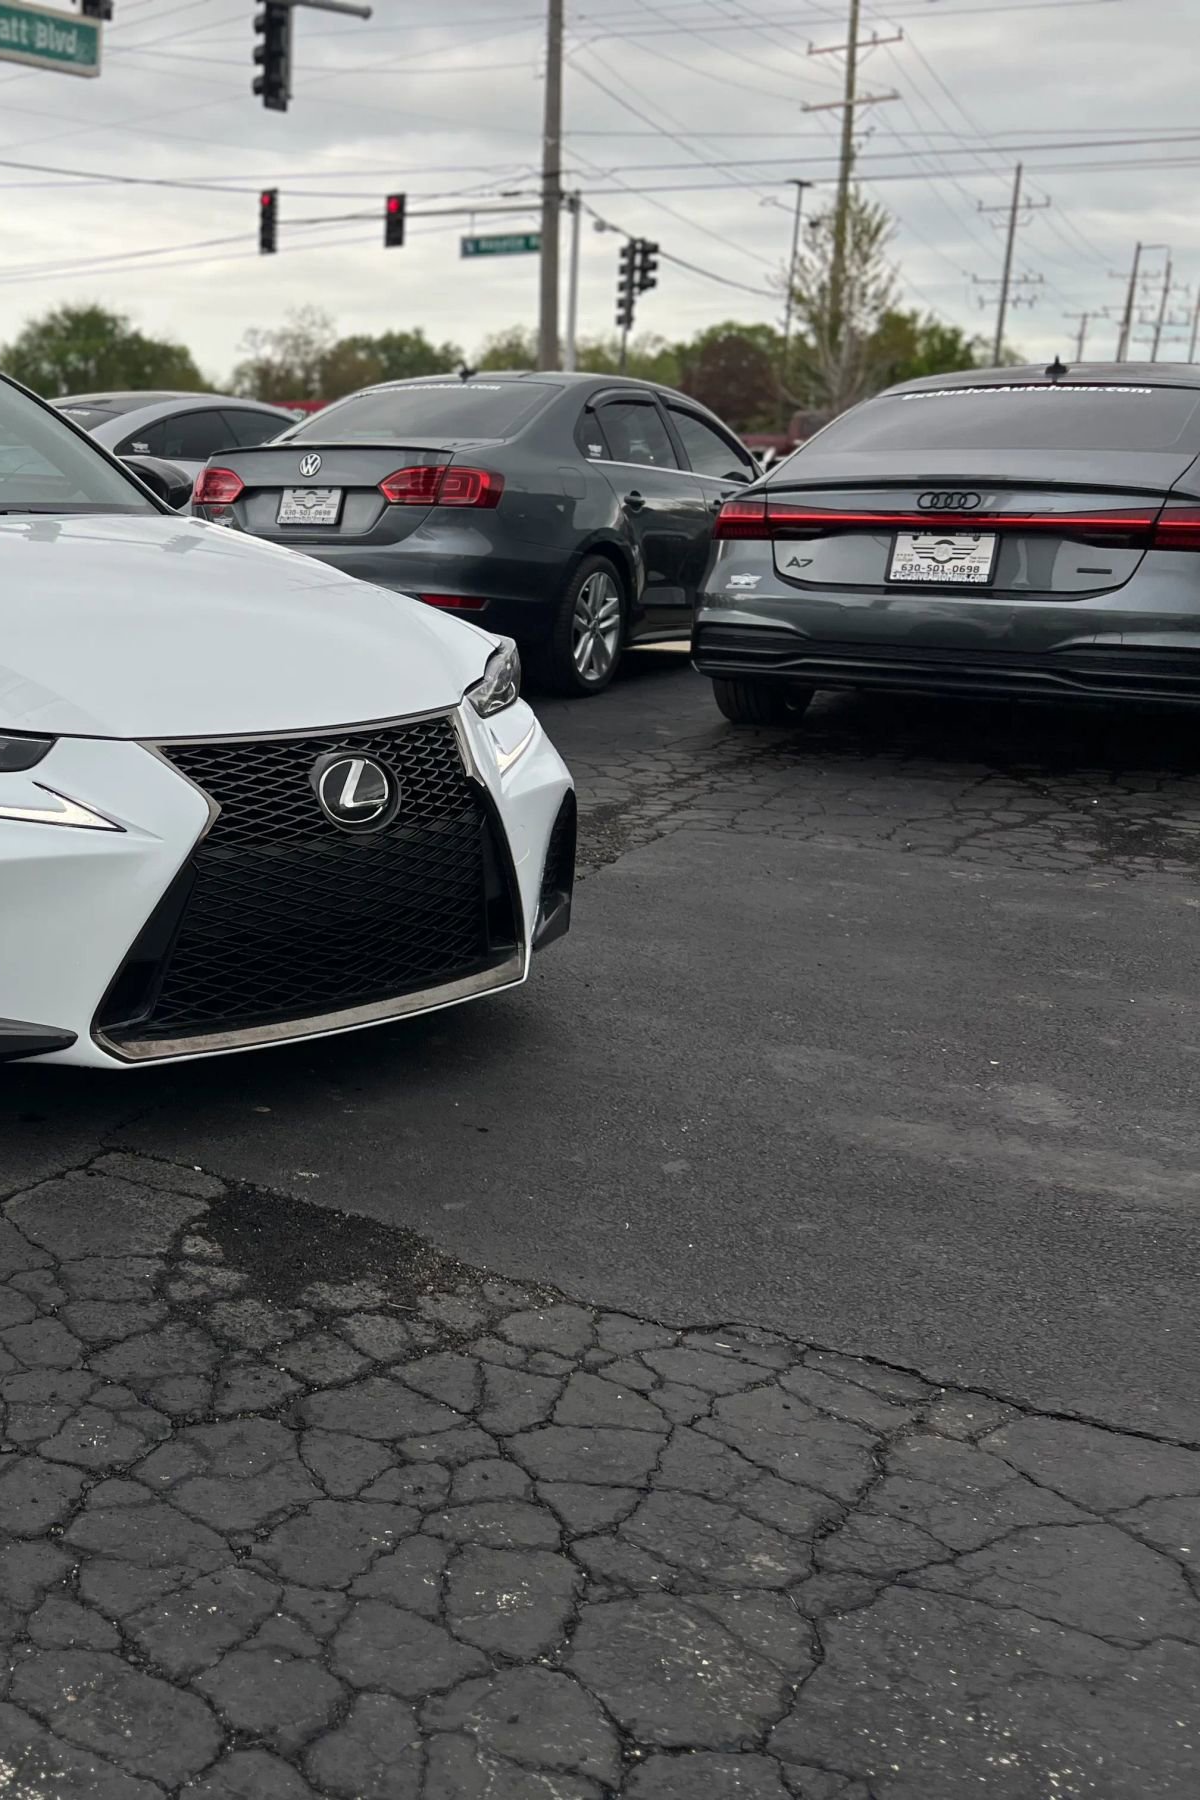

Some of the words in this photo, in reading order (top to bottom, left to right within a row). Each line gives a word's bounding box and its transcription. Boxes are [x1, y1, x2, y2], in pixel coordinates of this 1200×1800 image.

[34, 22, 78, 53] Blvd
[785, 556, 814, 568] A7
[901, 563, 980, 573] 630-501-0698
